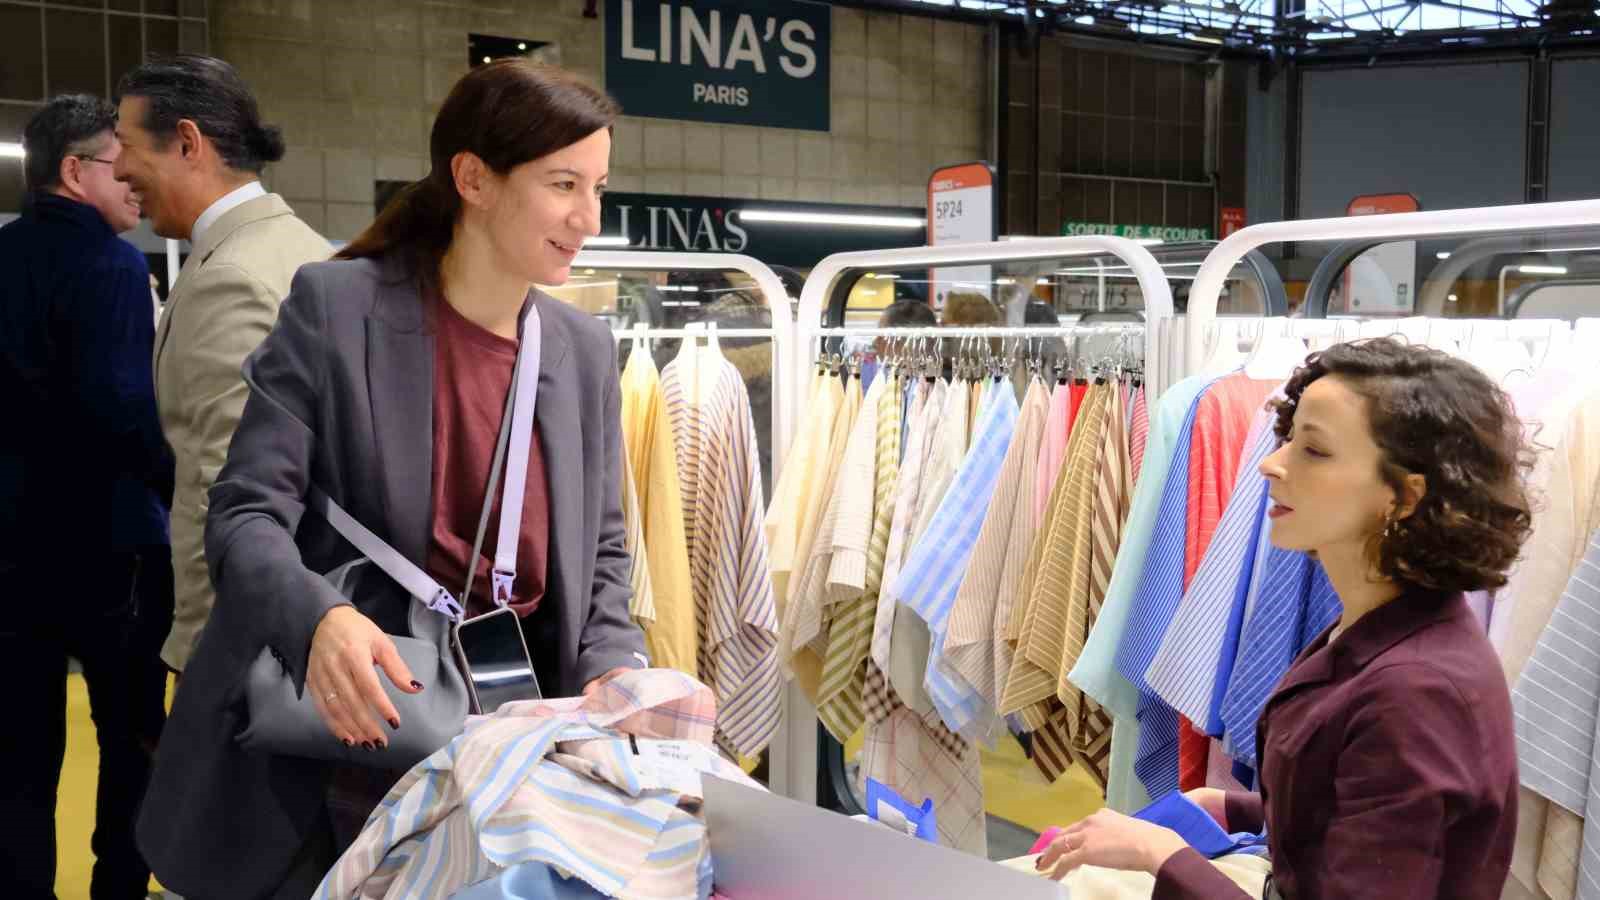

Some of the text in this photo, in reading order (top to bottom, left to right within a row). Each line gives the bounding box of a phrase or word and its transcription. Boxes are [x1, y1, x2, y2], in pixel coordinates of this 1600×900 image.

[621, 0, 816, 79] LINA'S
[693, 82, 749, 107] PARIS
[936, 199, 962, 220] 5P24
[618, 205, 747, 252] LINA'S
[1066, 222, 1208, 242] SORTIE DE SECOURS
